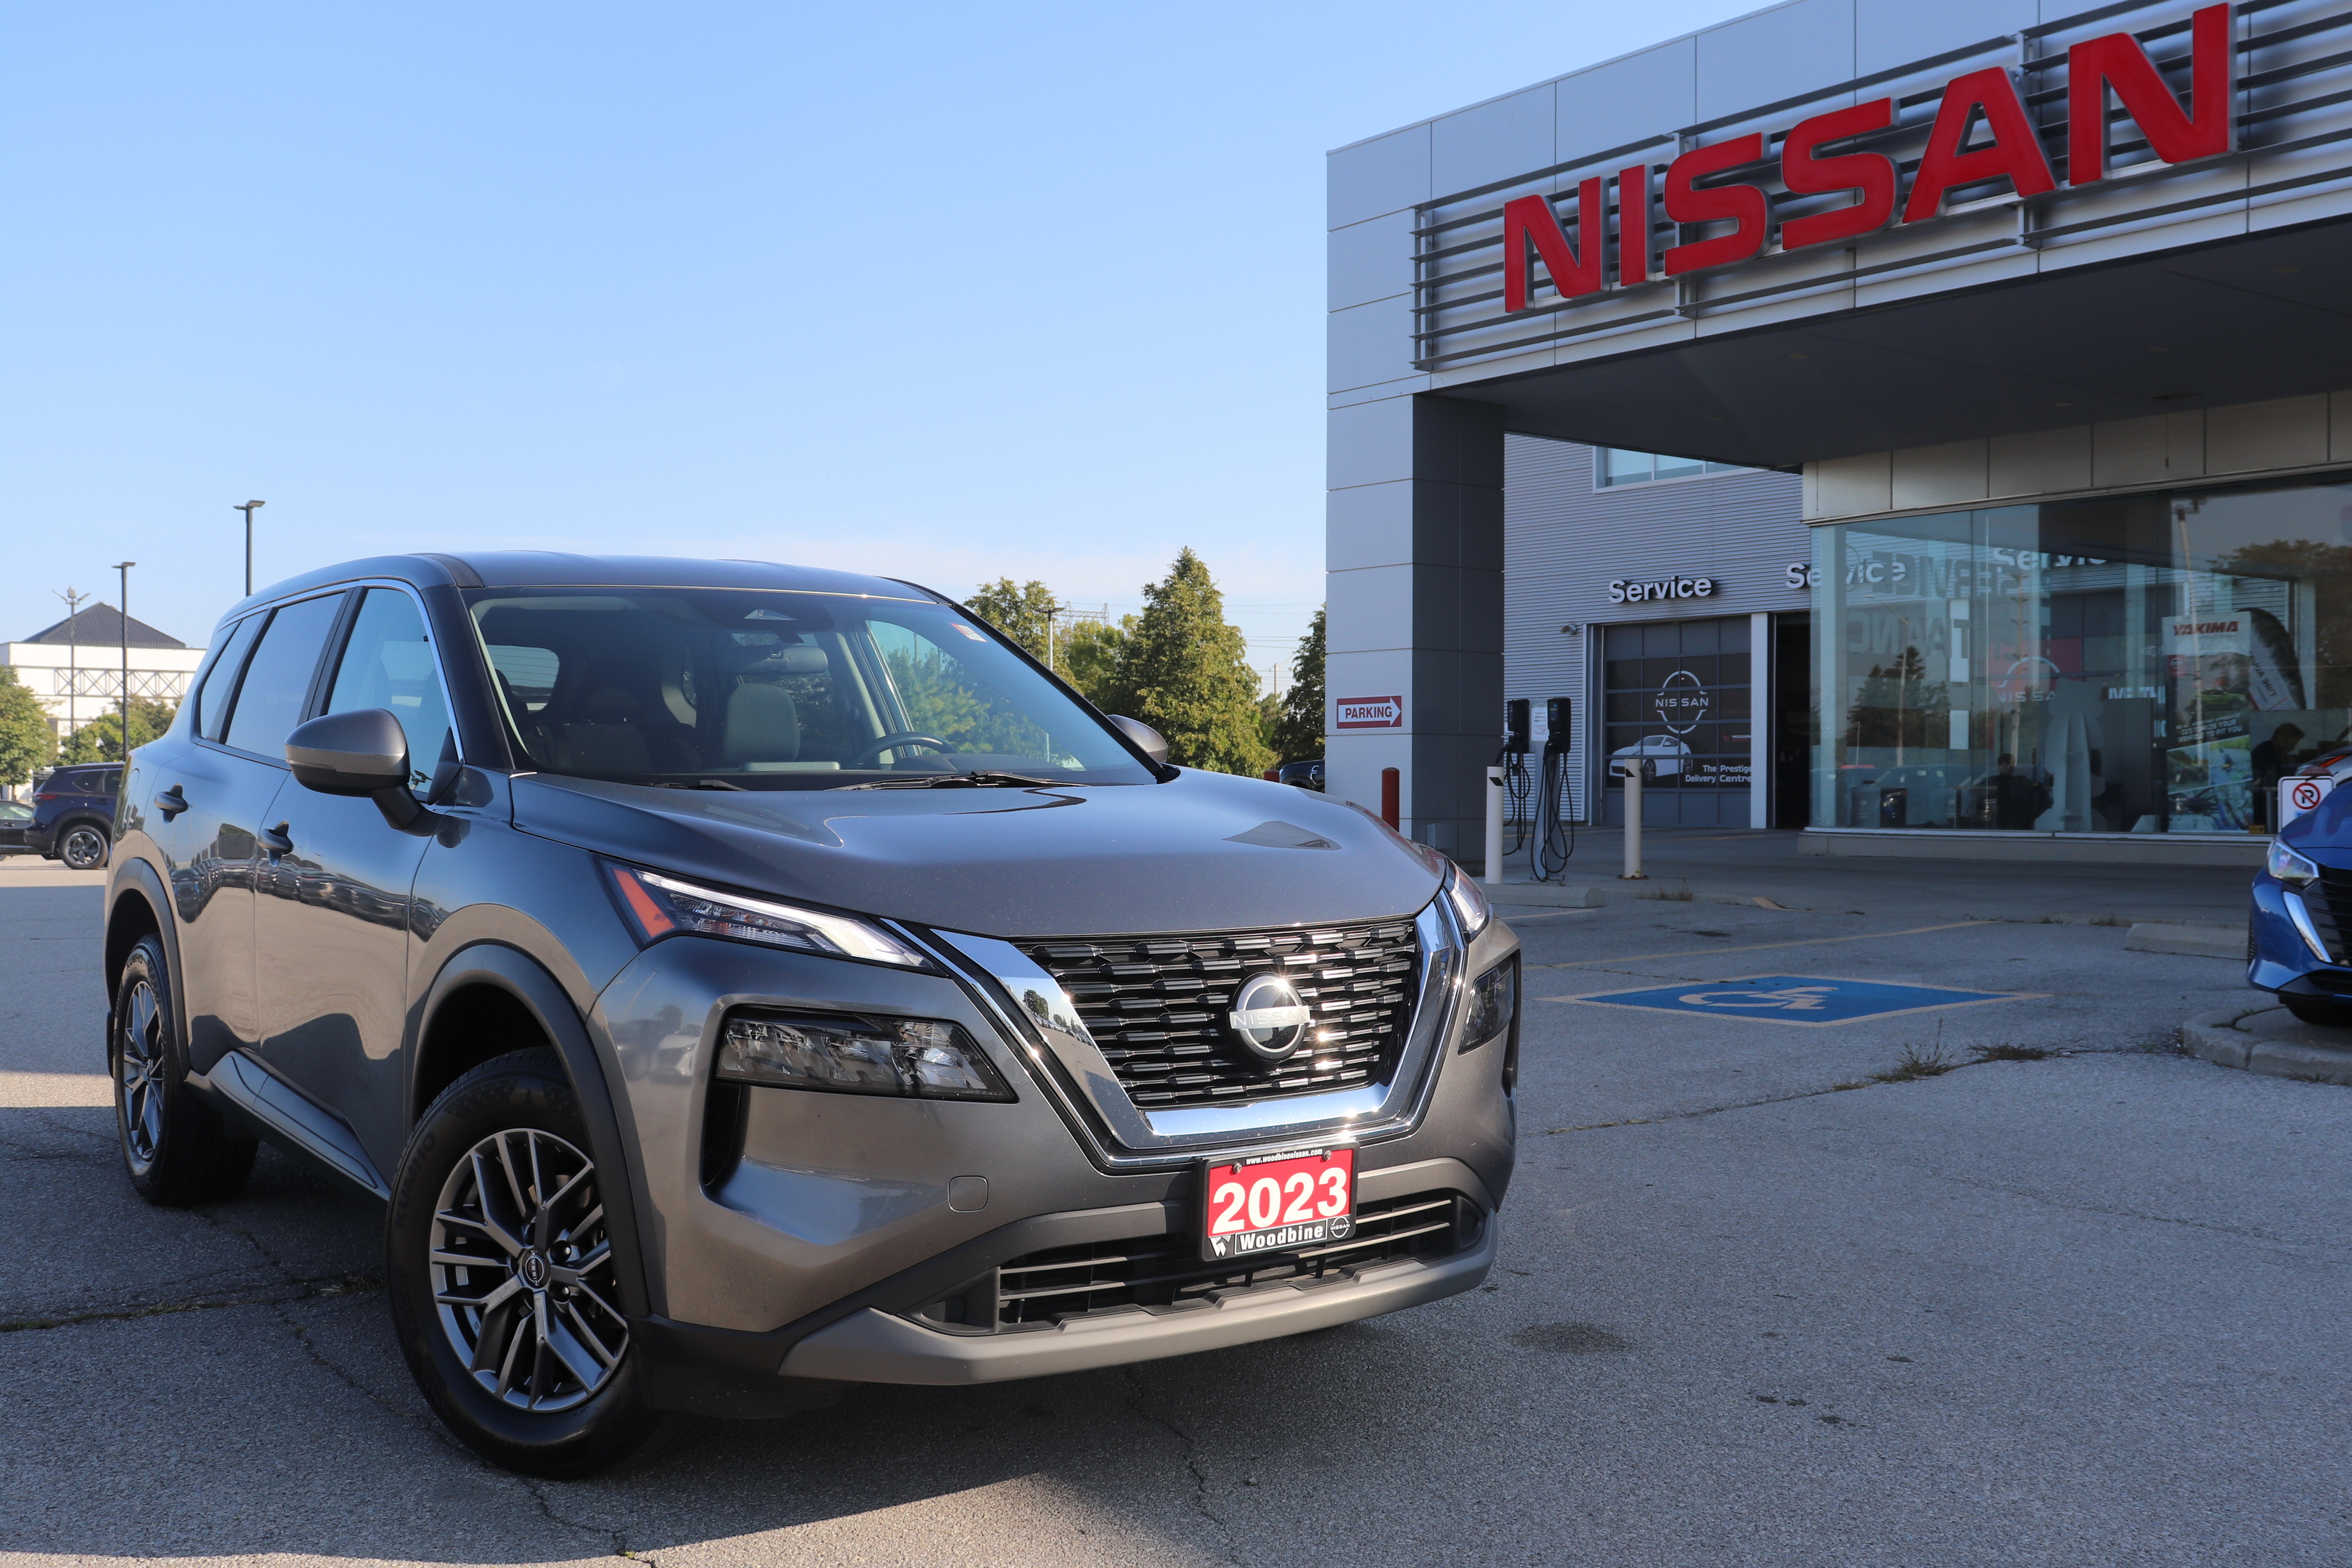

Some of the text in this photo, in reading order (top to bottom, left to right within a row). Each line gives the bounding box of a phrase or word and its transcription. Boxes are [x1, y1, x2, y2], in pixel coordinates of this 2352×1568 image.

[1503, 1, 2236, 314] NISSAN
[1608, 576, 1712, 603] Service
[2173, 621, 2239, 636] YAKIMA
[1656, 698, 1709, 707] NISSAN
[1996, 691, 2057, 702] NISSA
[1345, 706, 1392, 719] PARKING
[2181, 719, 2237, 735] CUSTOMIZE YOUR
[1685, 775, 1716, 783] Delivery
[1234, 1009, 1308, 1026] NISSAN
[1246, 1148, 1323, 1165] www.woodbinenissan.com
[394, 1132, 436, 1230] KUMHO
[1212, 1167, 1347, 1234] 2023
[1330, 1222, 1350, 1232] NISSAN
[1239, 1225, 1324, 1250] Woodbine
[531, 1252, 539, 1286] NISSAN
